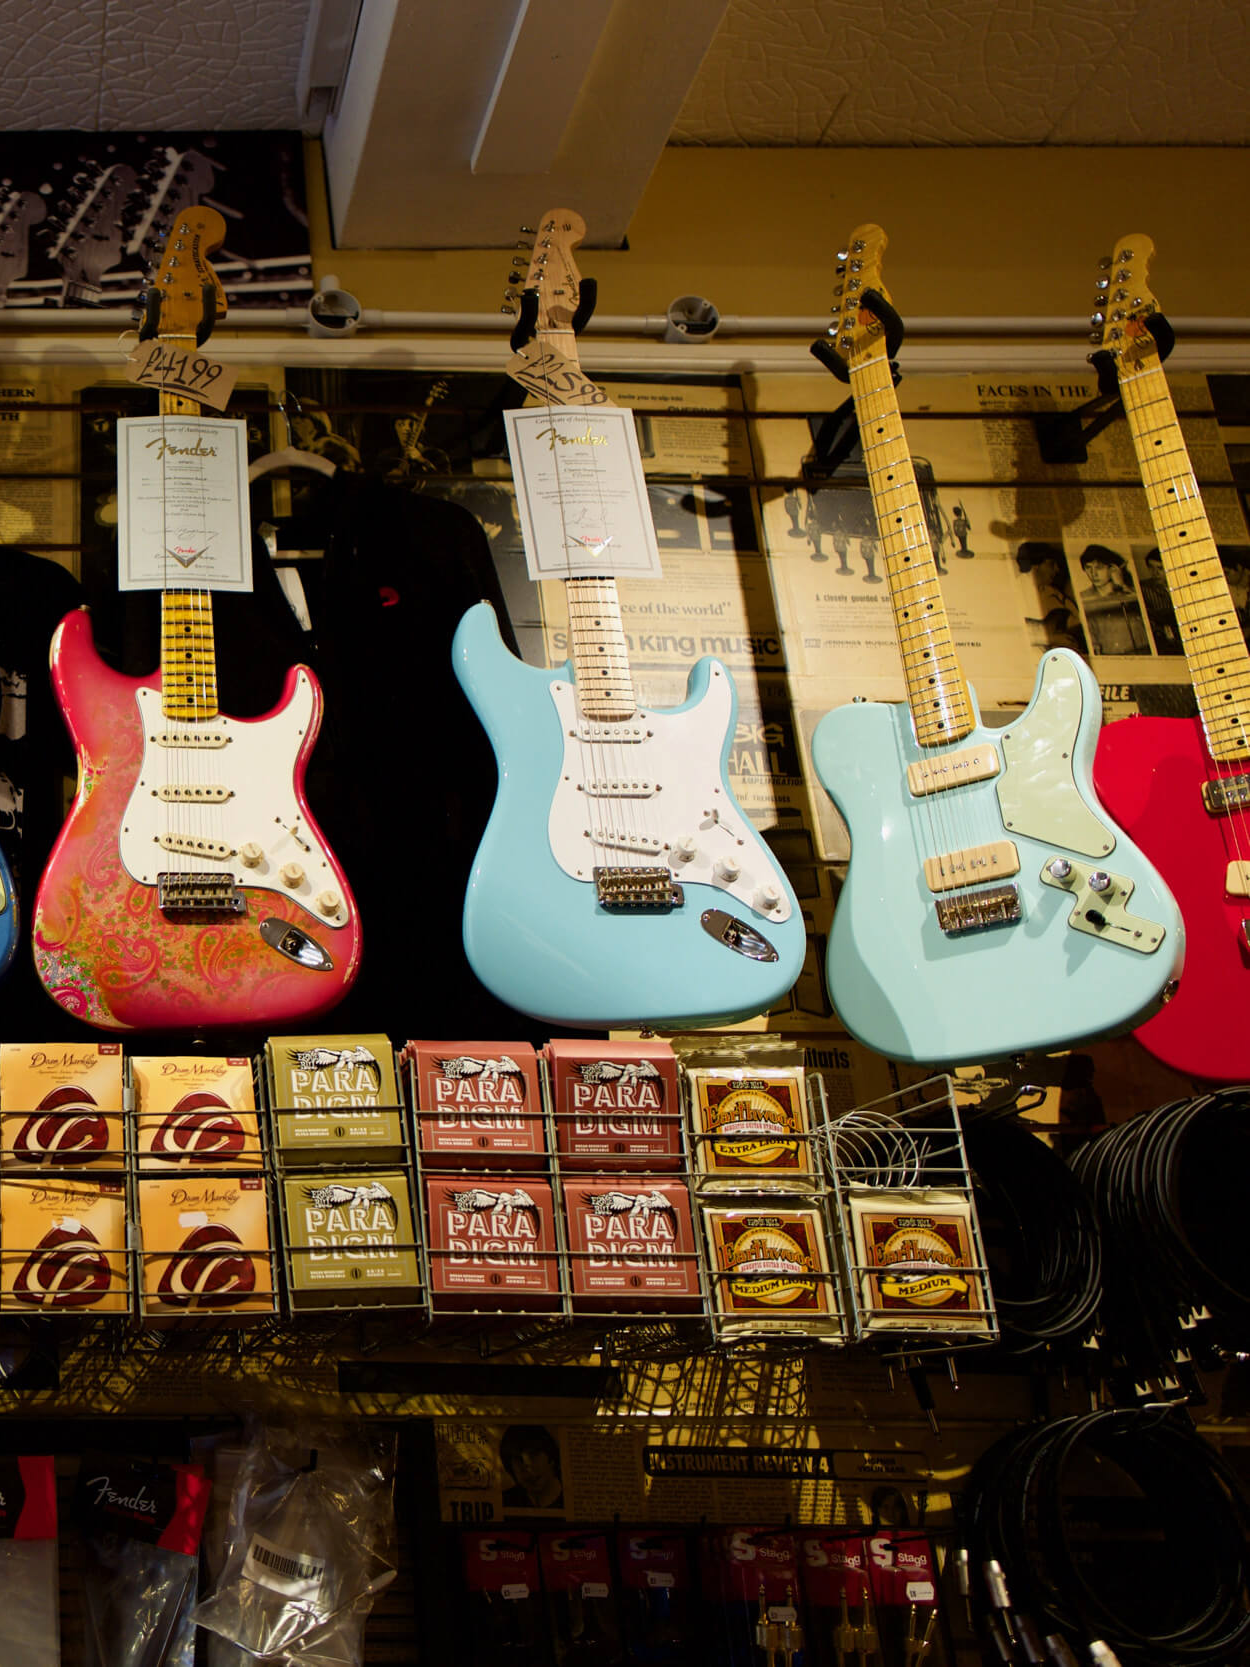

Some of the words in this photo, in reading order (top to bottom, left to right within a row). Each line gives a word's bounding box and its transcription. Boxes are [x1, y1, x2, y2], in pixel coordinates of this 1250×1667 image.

[136, 346, 222, 389] £4199
[977, 385, 1029, 397] FACES
[1031, 385, 1052, 397] IN
[1055, 385, 1090, 397] THE
[145, 437, 218, 461] Fender
[536, 427, 610, 451] Fender
[639, 602, 653, 614] of
[657, 602, 682, 615] the
[639, 633, 696, 657] King
[700, 634, 781, 656] music
[291, 1068, 379, 1093] PARA
[435, 1078, 523, 1103] PARA
[293, 1094, 381, 1120] DIGM
[574, 1083, 661, 1108] PARA
[437, 1104, 525, 1129] DIGM
[575, 1109, 662, 1135] DIGM
[703, 1100, 800, 1133] Earthwood
[719, 1142, 757, 1154] EXTRA
[305, 1206, 395, 1233] PARA
[447, 1210, 537, 1238] PARA
[585, 1213, 675, 1240] PARA
[308, 1234, 399, 1260] DIGM
[449, 1238, 539, 1266] DIGM
[587, 1241, 678, 1268] DIGM
[720, 1239, 820, 1271] Earthwood
[869, 1239, 968, 1268] Earthwood
[734, 1282, 780, 1294] MEDIUM
[781, 1277, 815, 1288] LIGHT
[898, 1278, 951, 1295] MEDIUM
[648, 1451, 750, 1475] INSTRUMENT
[753, 1452, 814, 1475] REVIEW
[817, 1454, 831, 1474] 4
[86, 1475, 158, 1514] Fender
[758, 1547, 790, 1562] Stagg
[830, 1552, 861, 1567] Stagg
[897, 1552, 928, 1567] Stagg
